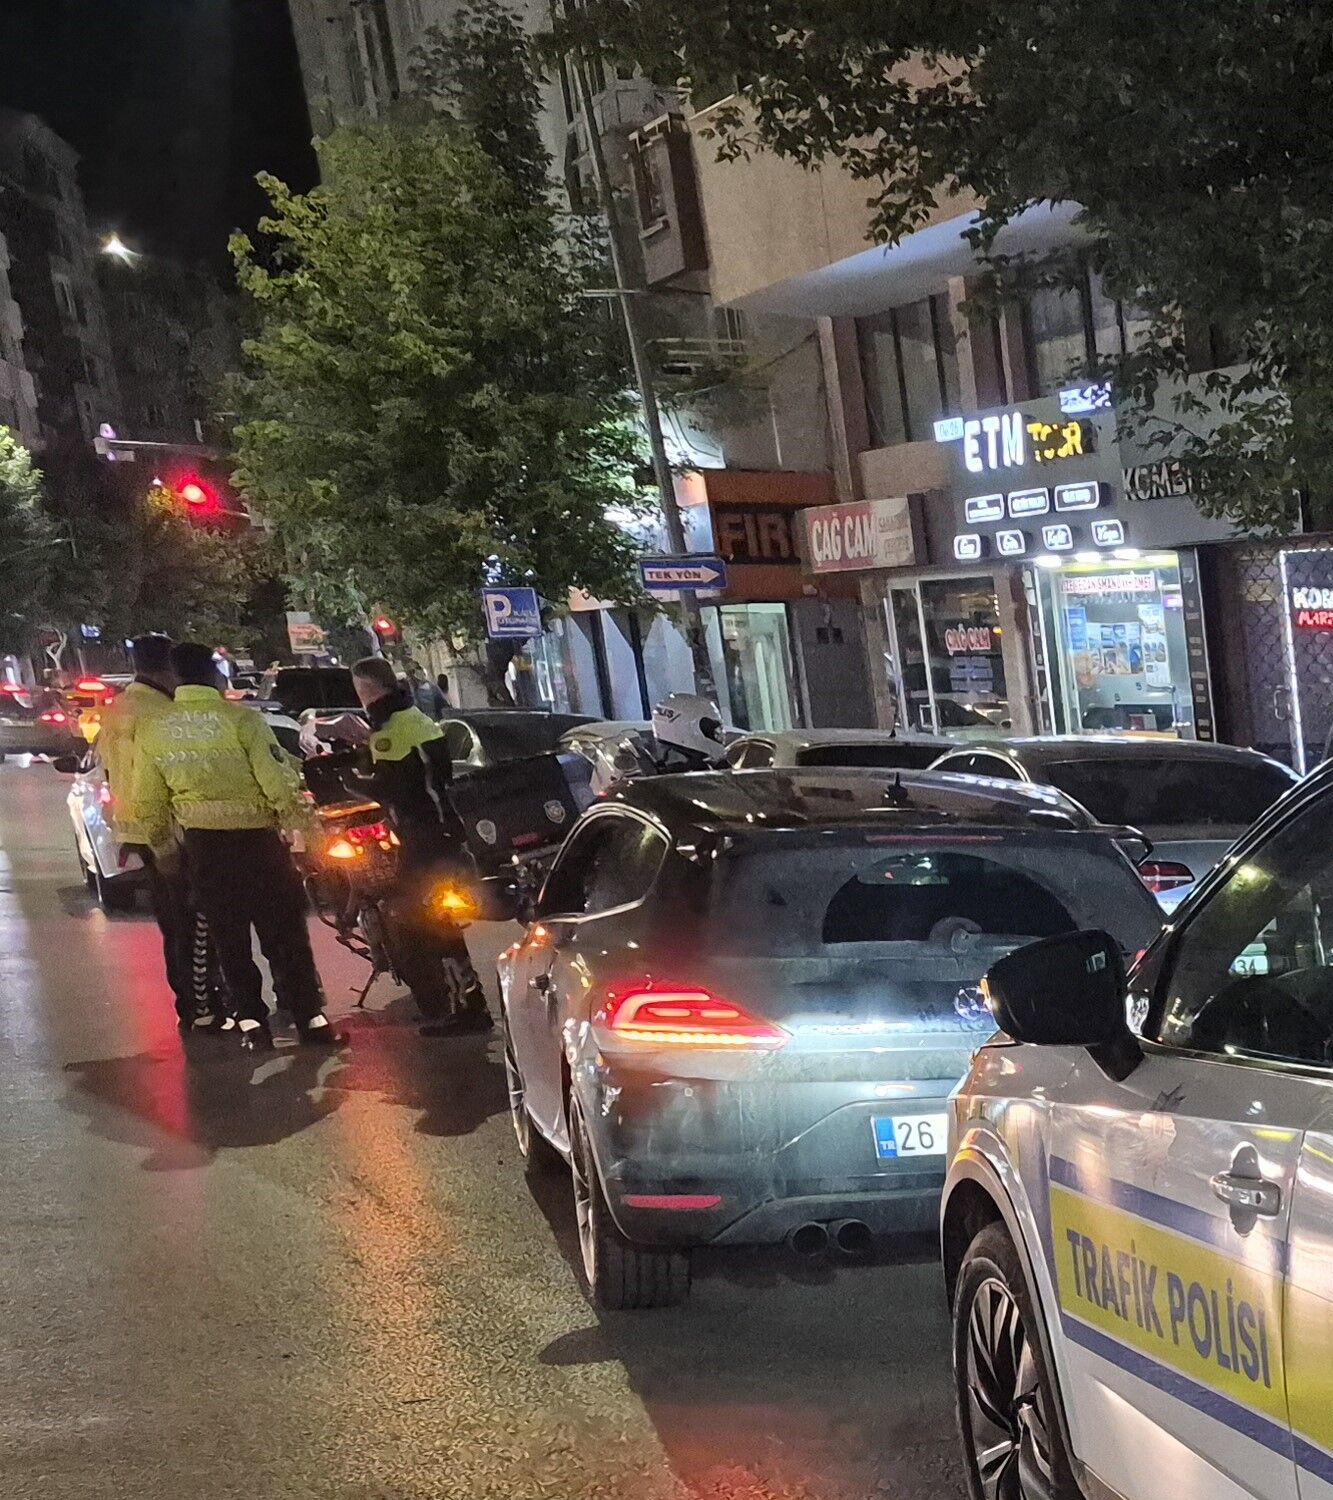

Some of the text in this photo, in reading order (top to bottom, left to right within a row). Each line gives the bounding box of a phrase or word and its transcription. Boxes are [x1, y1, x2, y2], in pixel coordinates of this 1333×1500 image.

[964, 411, 1024, 472] ETM
[812, 512, 842, 568] ÇAĞ
[844, 513, 877, 560] CAM
[648, 568, 702, 581] TEK YÖN
[485, 593, 512, 632] P
[897, 1120, 935, 1151] 26
[1065, 1227, 1165, 1340] TRAFİK
